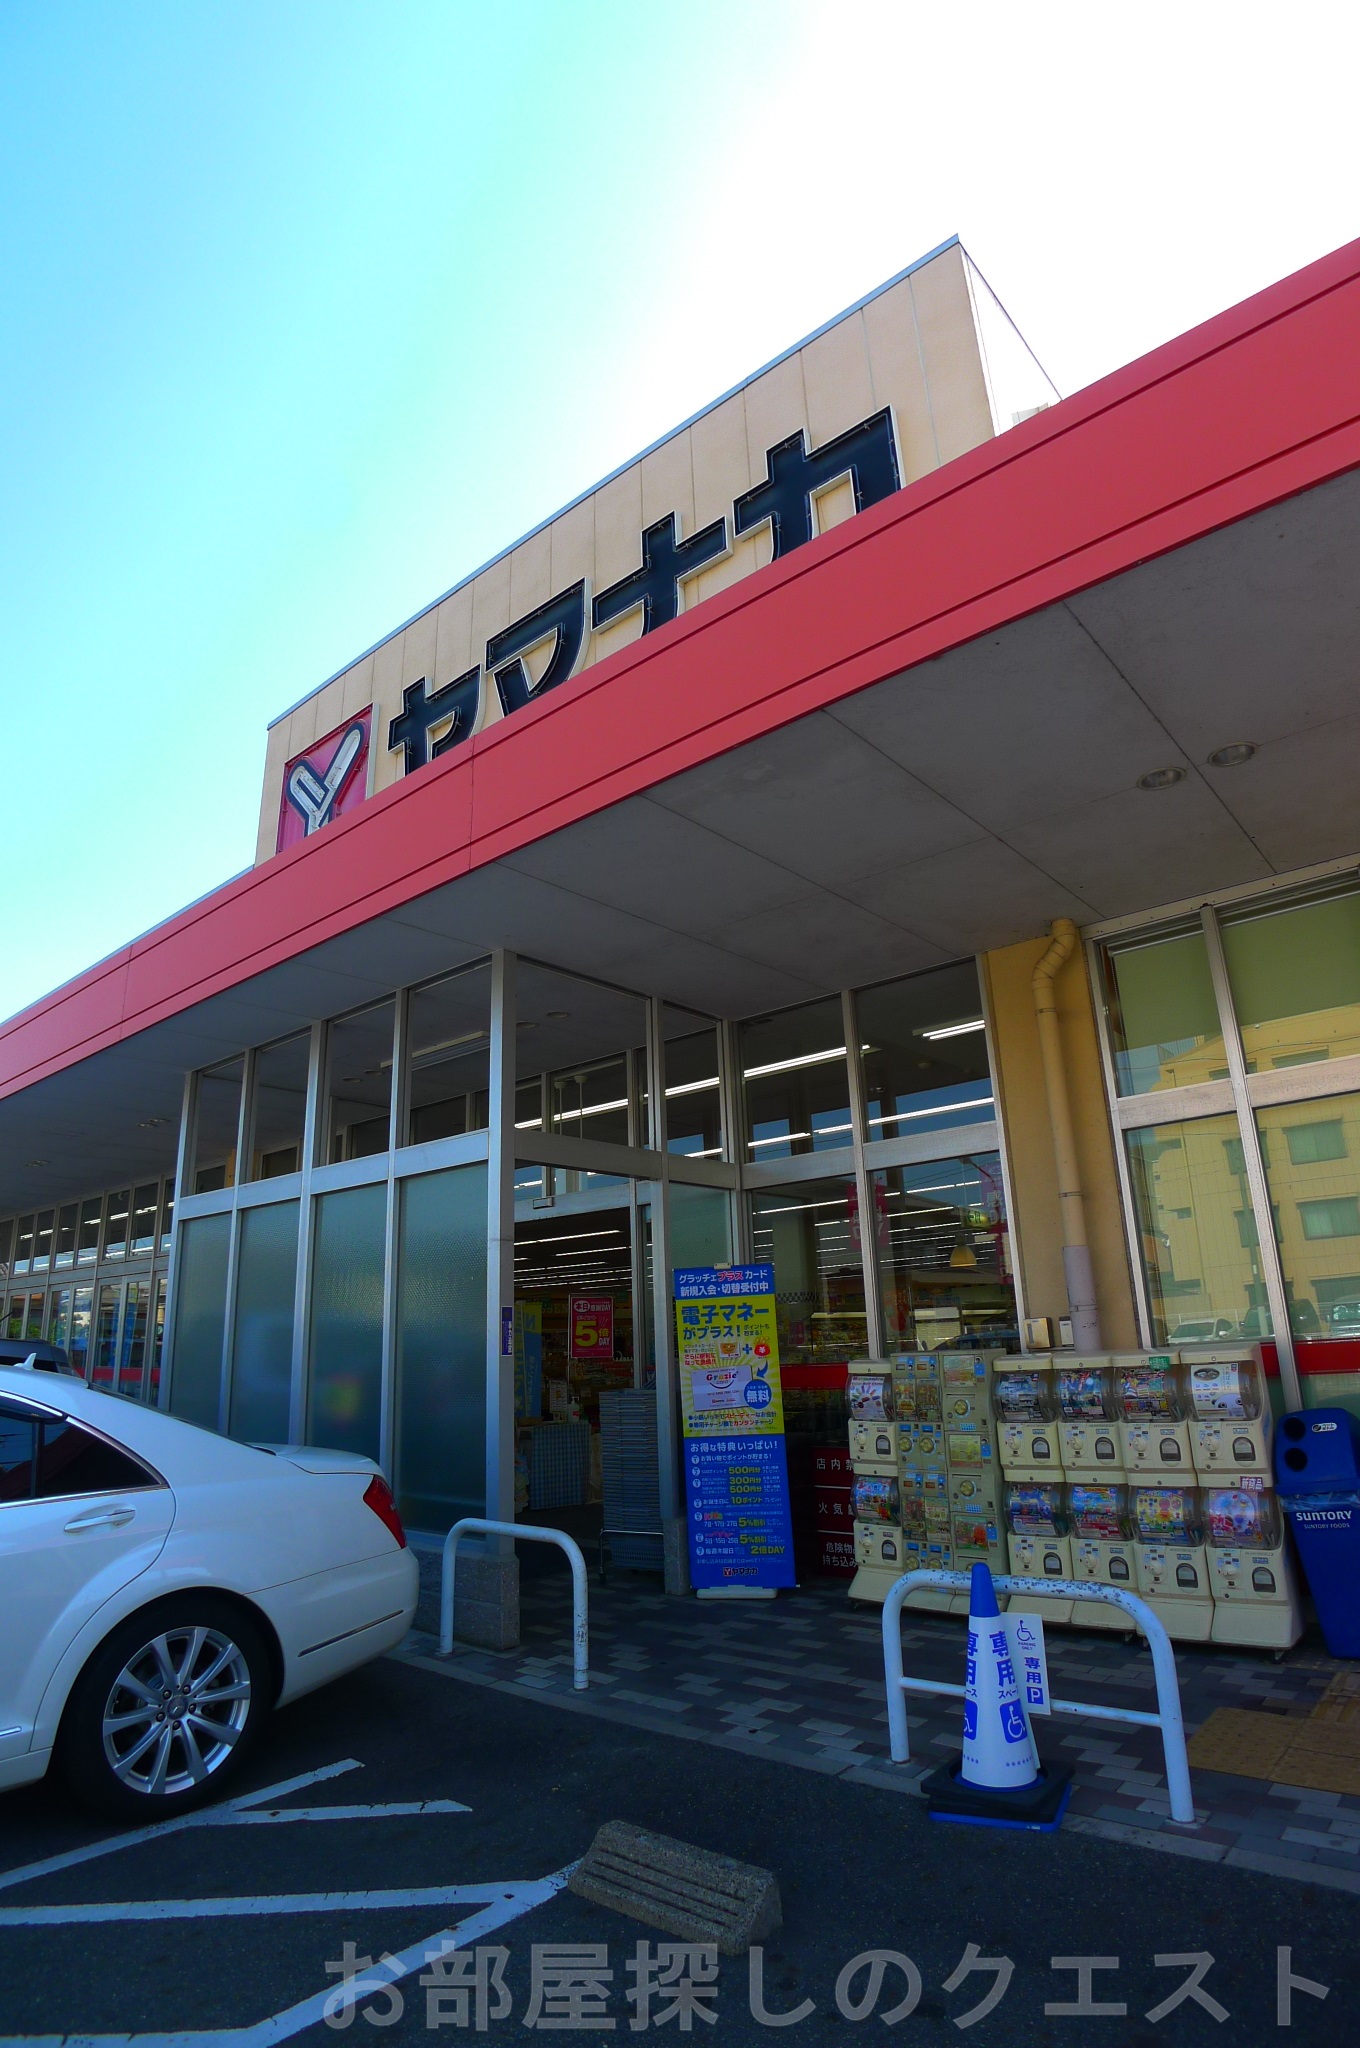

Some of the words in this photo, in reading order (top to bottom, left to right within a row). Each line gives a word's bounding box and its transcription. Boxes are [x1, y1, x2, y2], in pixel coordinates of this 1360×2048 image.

[388, 404, 904, 776] ヤマナカ
[680, 1281, 769, 1297] 新規入会・切替受付中
[681, 1302, 769, 1325] 電子マネー
[574, 1320, 599, 1347] 5
[598, 1328, 610, 1338] 倍
[683, 1325, 741, 1340] がプラス!
[598, 1337, 610, 1346] DAY
[746, 1389, 770, 1403] 無料
[690, 1440, 778, 1453] お得な特典いっぱい!
[728, 1466, 761, 1475] 500円分
[729, 1476, 762, 1485] 300円分
[1241, 1477, 1263, 1491] 新商品
[729, 1485, 762, 1493] 500円分
[731, 1496, 763, 1505] 10ポイント
[750, 1545, 785, 1554] 2倍DAY
[826, 1541, 855, 1554] 危険物
[732, 1566, 759, 1576] ヤマナカ
[989, 1630, 1016, 1688] 専用
[1024, 1656, 1042, 1684] 専用
